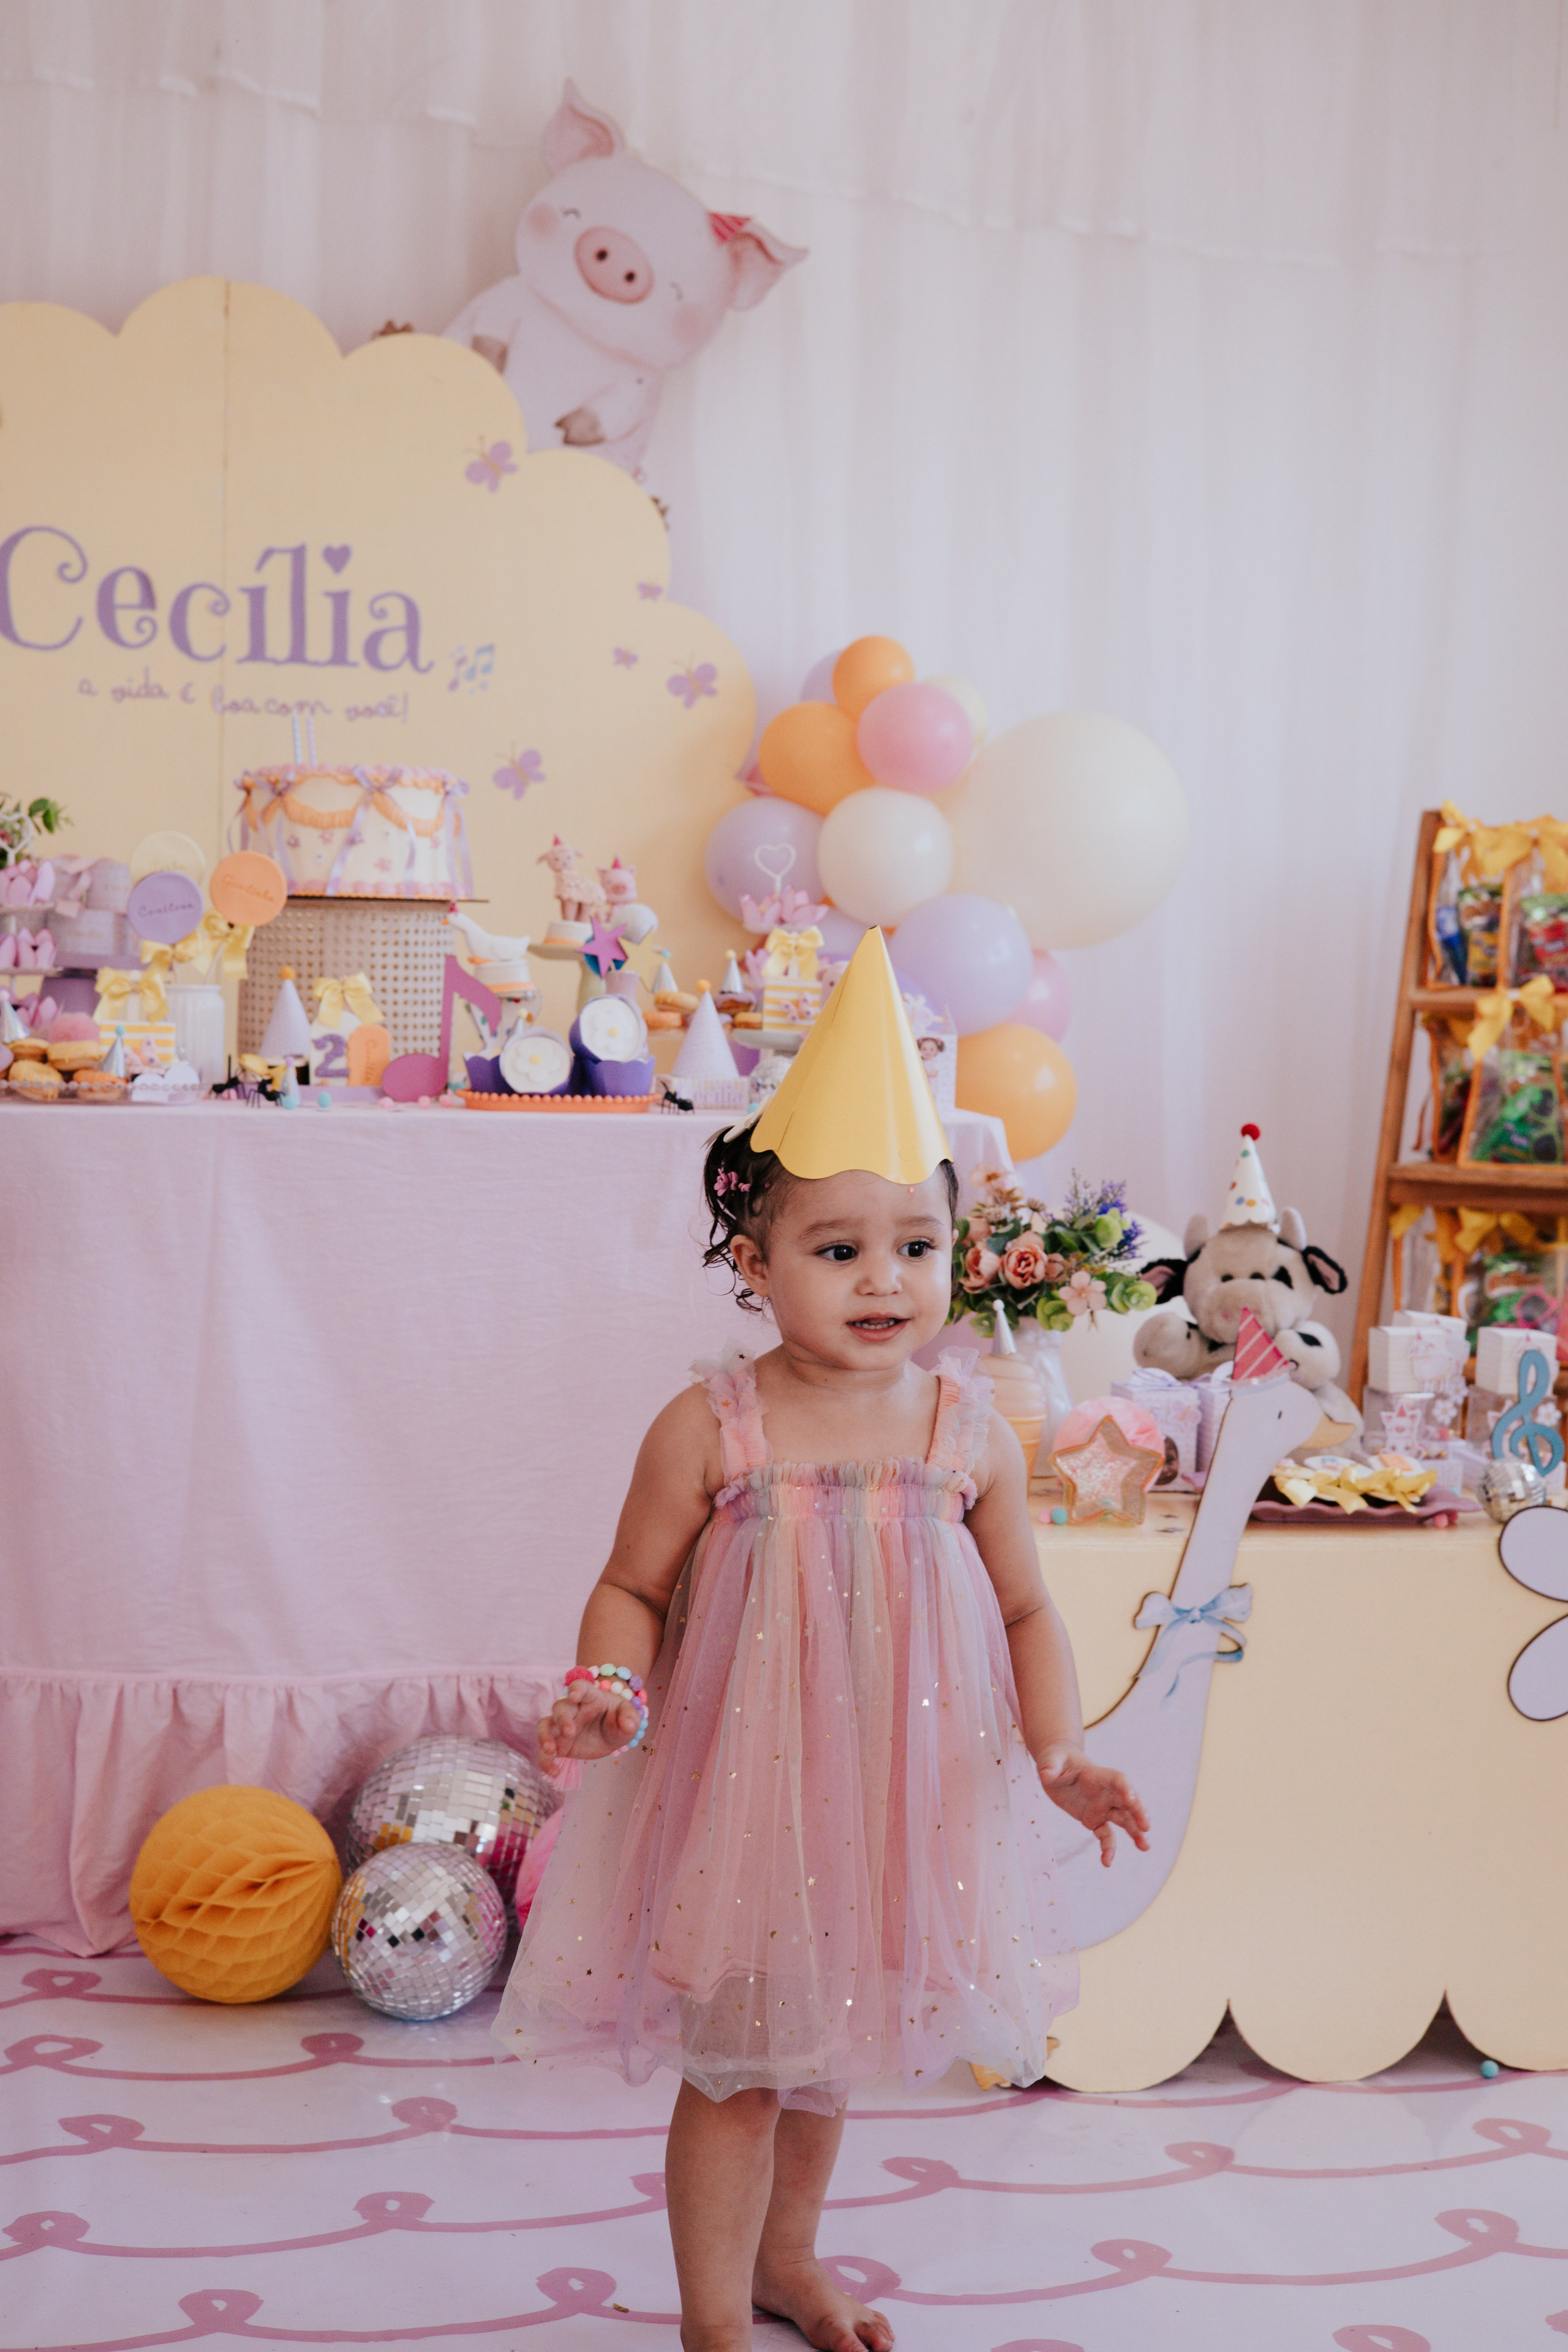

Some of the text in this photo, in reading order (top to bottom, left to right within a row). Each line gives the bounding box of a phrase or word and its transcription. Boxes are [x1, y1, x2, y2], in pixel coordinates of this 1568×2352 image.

[0, 525, 435, 675] Cecília
[78, 677, 98, 697] a
[111, 665, 170, 704] vida
[212, 684, 260, 714] boa
[312, 1033, 350, 1078] 2
